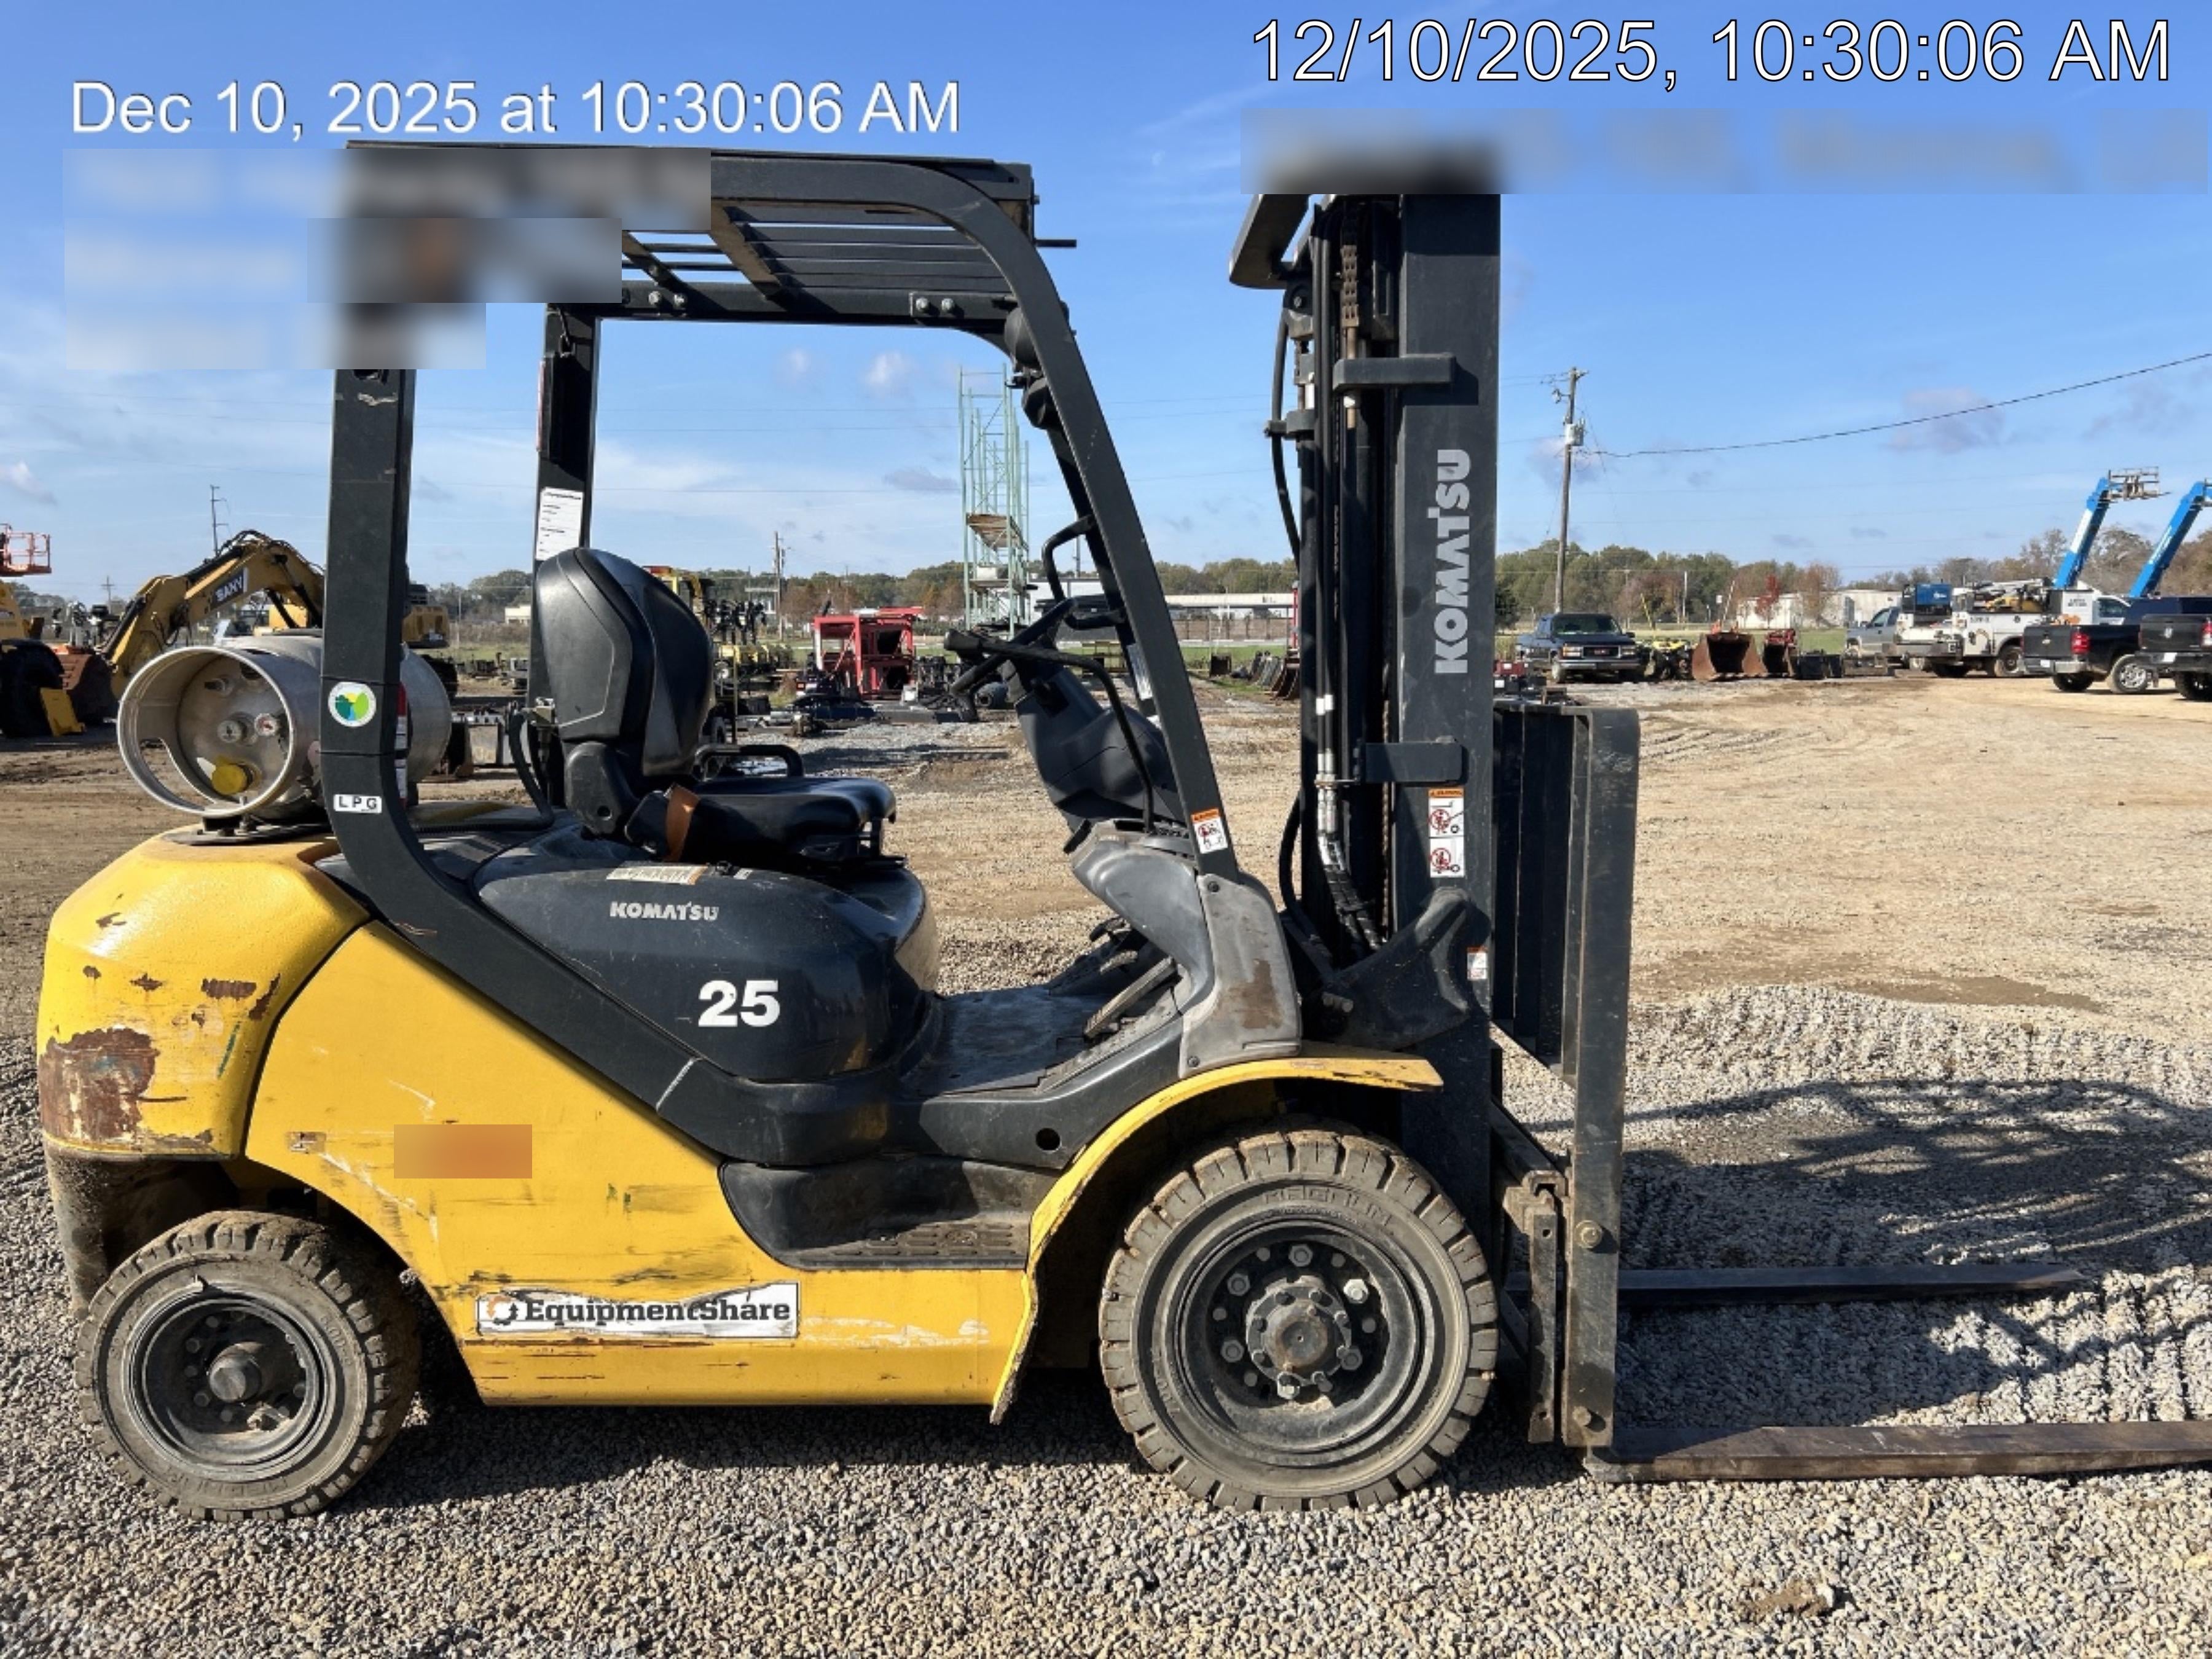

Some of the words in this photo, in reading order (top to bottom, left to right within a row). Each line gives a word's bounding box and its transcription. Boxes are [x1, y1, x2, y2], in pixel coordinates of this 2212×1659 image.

[1427, 449, 1471, 673] KOMATSU
[610, 901, 719, 921] KOMATSU
[697, 979, 781, 1027] 25
[525, 1299, 790, 1326] EquipmentShare
